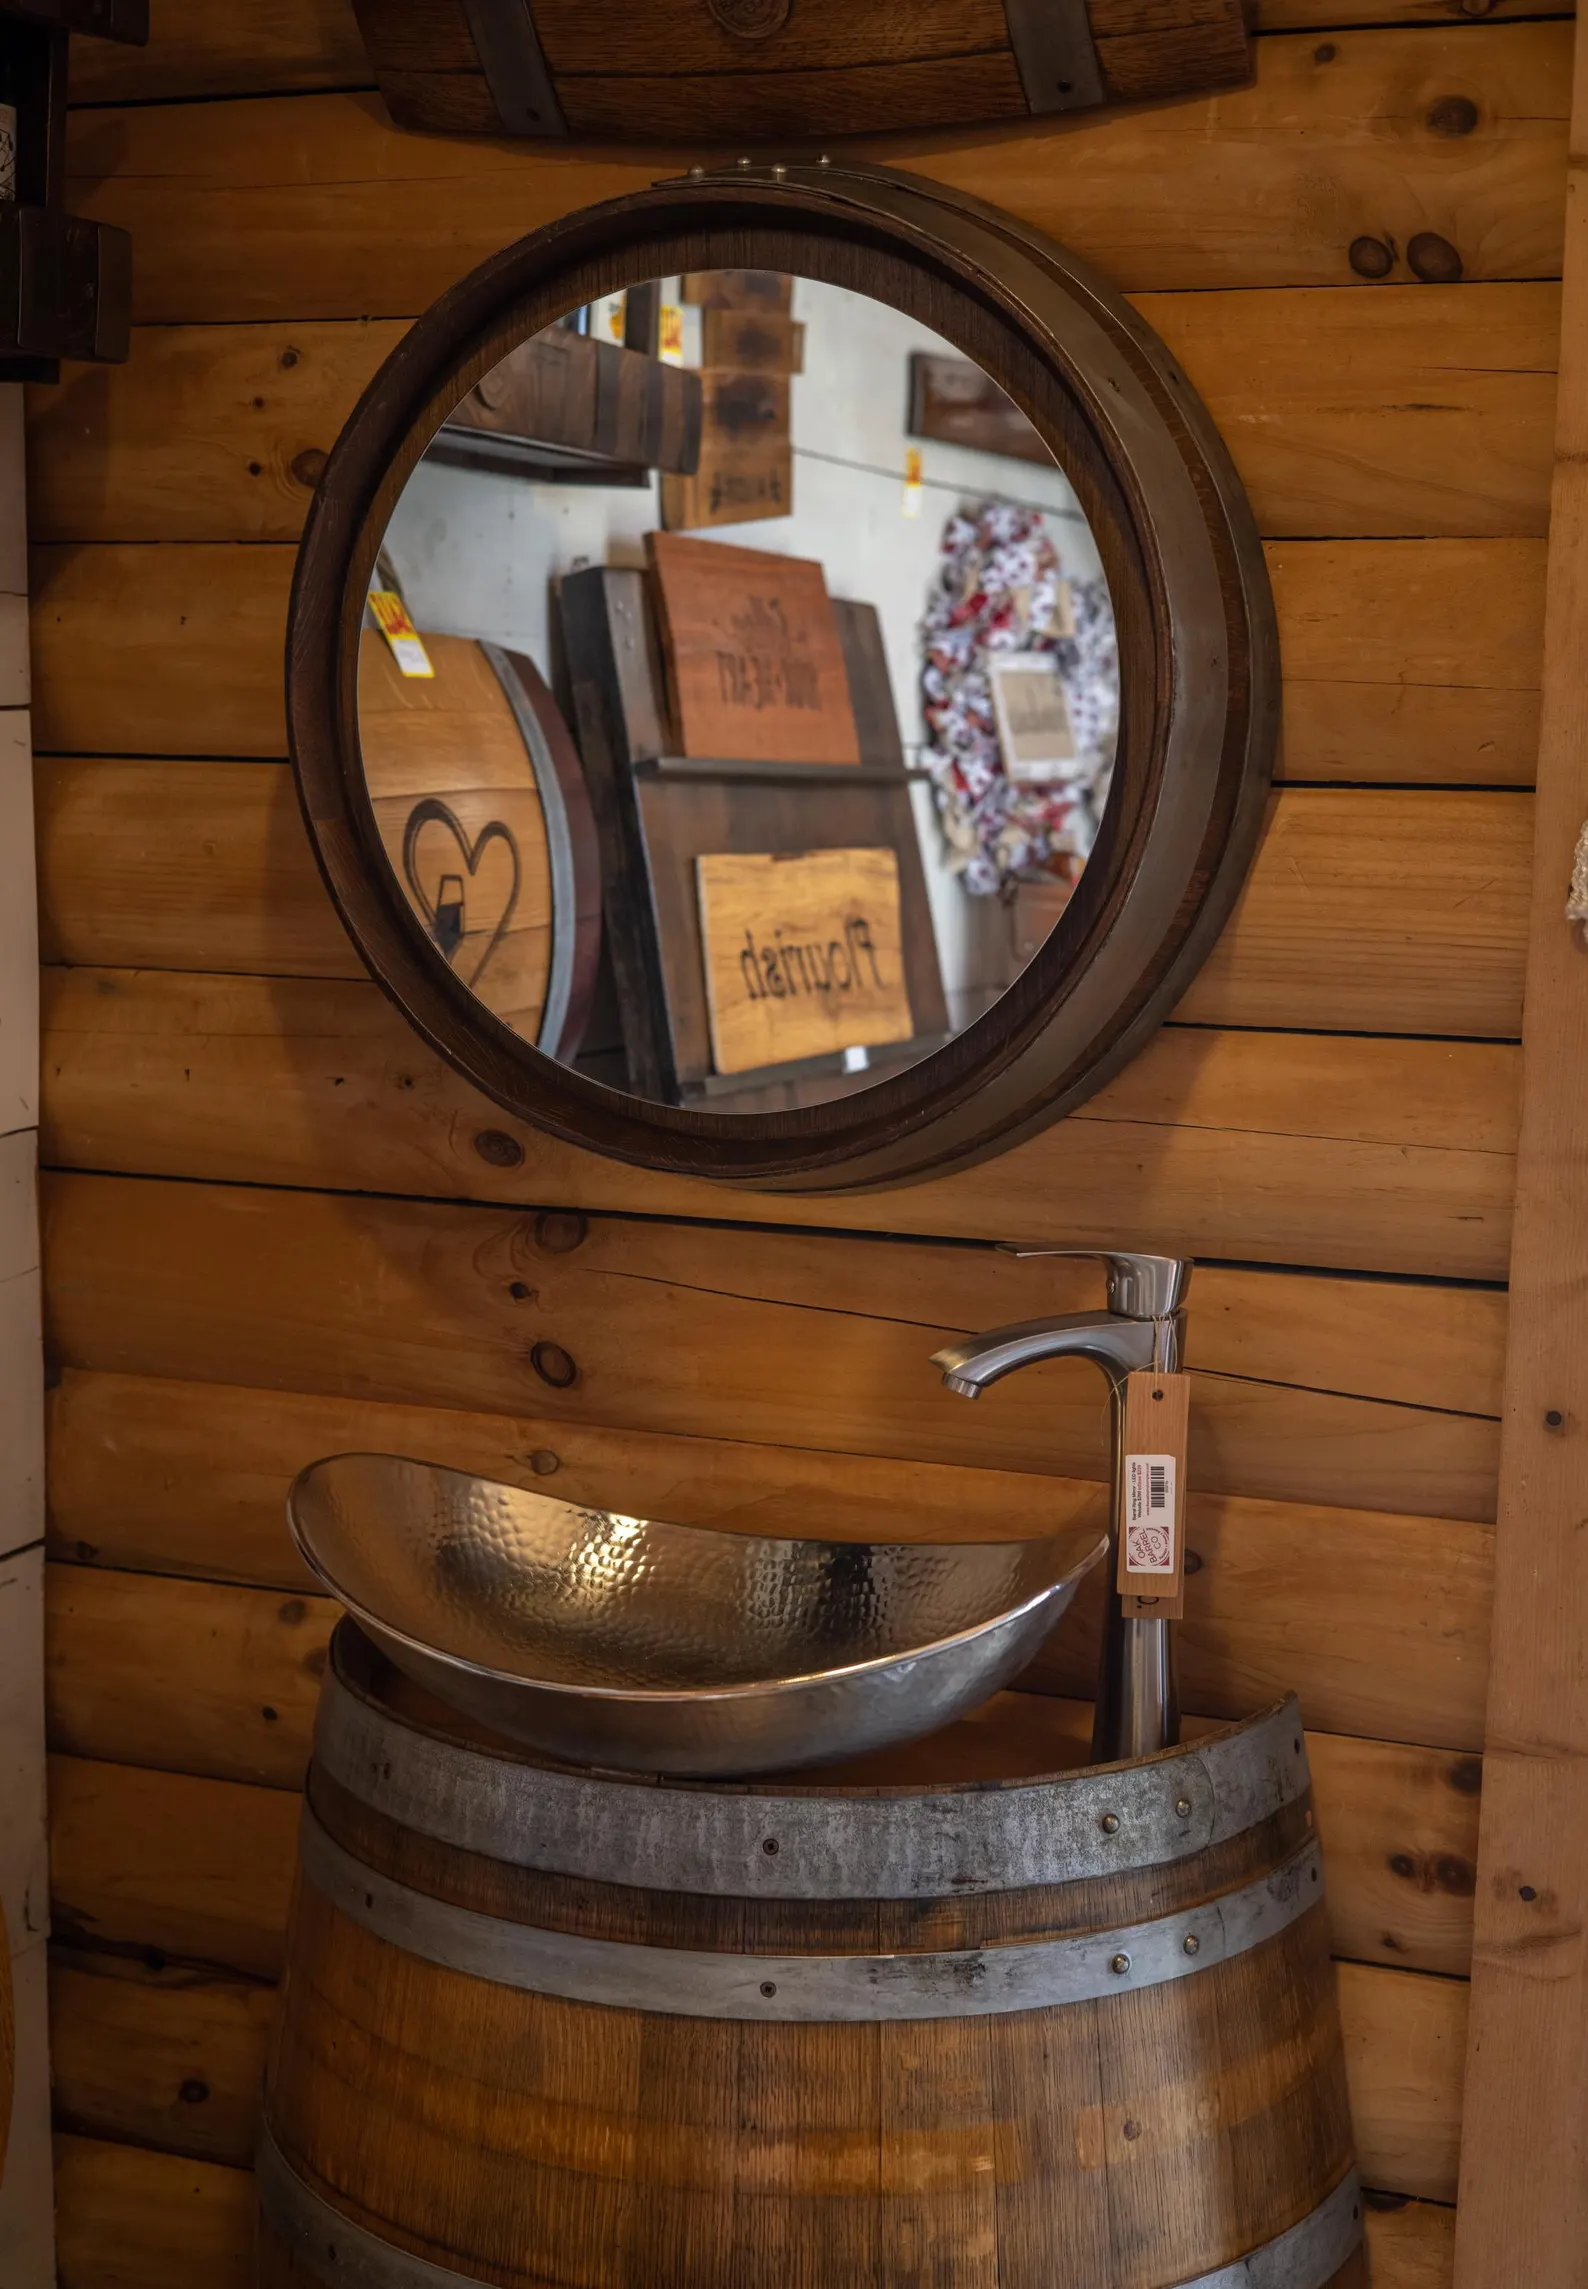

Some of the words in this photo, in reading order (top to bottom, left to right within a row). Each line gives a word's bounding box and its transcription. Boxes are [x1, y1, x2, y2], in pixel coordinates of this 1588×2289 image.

[1132, 1539, 1145, 1559] OAK
[1139, 1528, 1158, 1564] BARREL
[1150, 1536, 1162, 1550] CO
